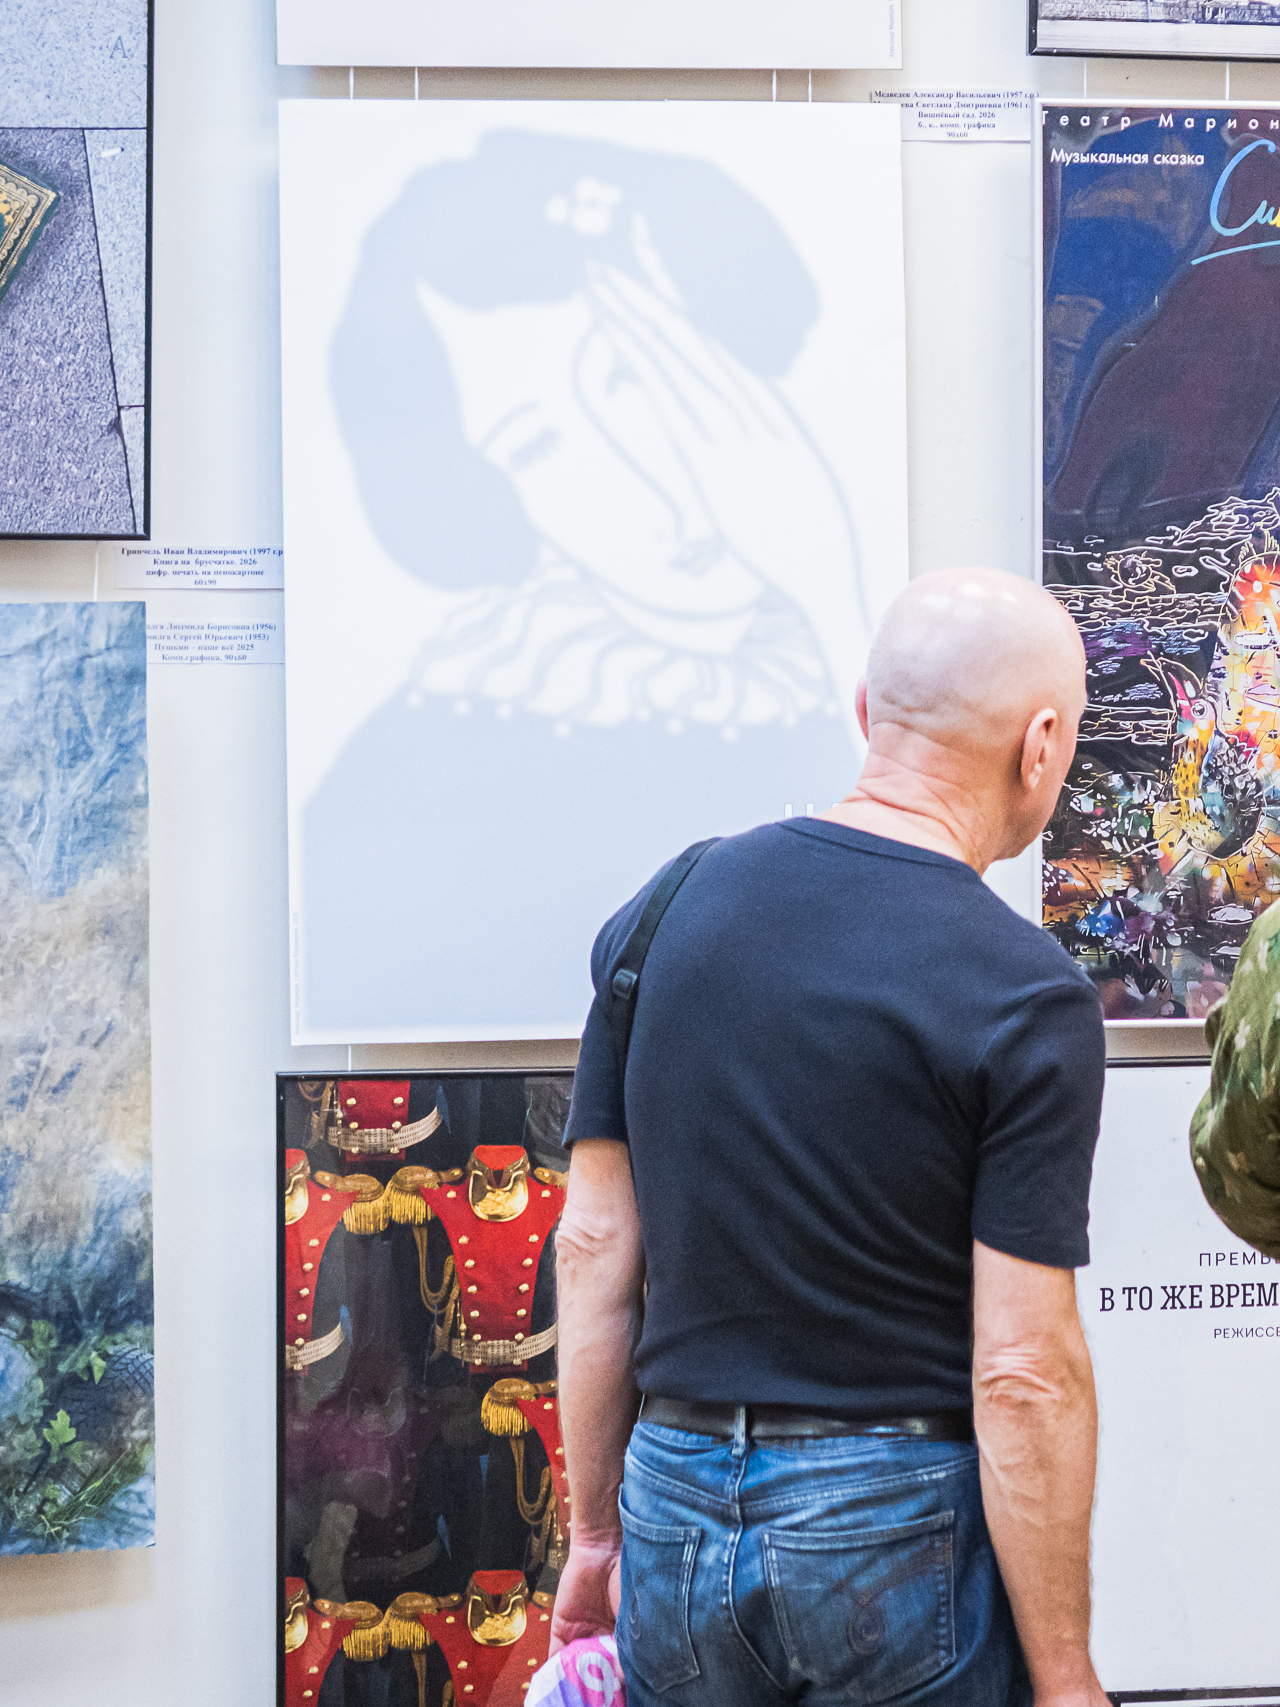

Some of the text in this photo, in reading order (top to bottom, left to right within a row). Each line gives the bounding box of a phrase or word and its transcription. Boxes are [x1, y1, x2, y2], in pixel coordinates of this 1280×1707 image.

[874, 90, 911, 98] Медведев
[913, 91, 954, 100] Александр
[1003, 91, 1023, 99] (1957
[954, 102, 1002, 110] Дмитриевна
[1003, 101, 1023, 109] (1961
[918, 110, 960, 118] Вишнёвый
[962, 111, 977, 119] сад.
[1042, 110, 1131, 132] Театр
[963, 122, 996, 130] графика
[1050, 147, 1205, 166] Музыкальная сказка
[121, 547, 161, 556] Гринчель
[187, 547, 248, 556] Владимирович
[249, 547, 271, 556] (1997
[153, 558, 179, 566] Книга
[194, 558, 237, 567] брусчатке.
[239, 558, 258, 566] 2026
[213, 569, 265, 577] пенокартоне
[166, 622, 277, 631] Людмила Борисовна (1956)
[173, 633, 202, 641] Сергей
[204, 633, 243, 641] Юрьевич
[245, 633, 270, 642] (1953)
[154, 643, 189, 652] Пушкин
[221, 643, 235, 651] всё
[236, 643, 255, 651] 2025
[1100, 1287, 1115, 1312] В
[1122, 1286, 1153, 1311] ТО
[1160, 1284, 1203, 1310] ЖЕ
